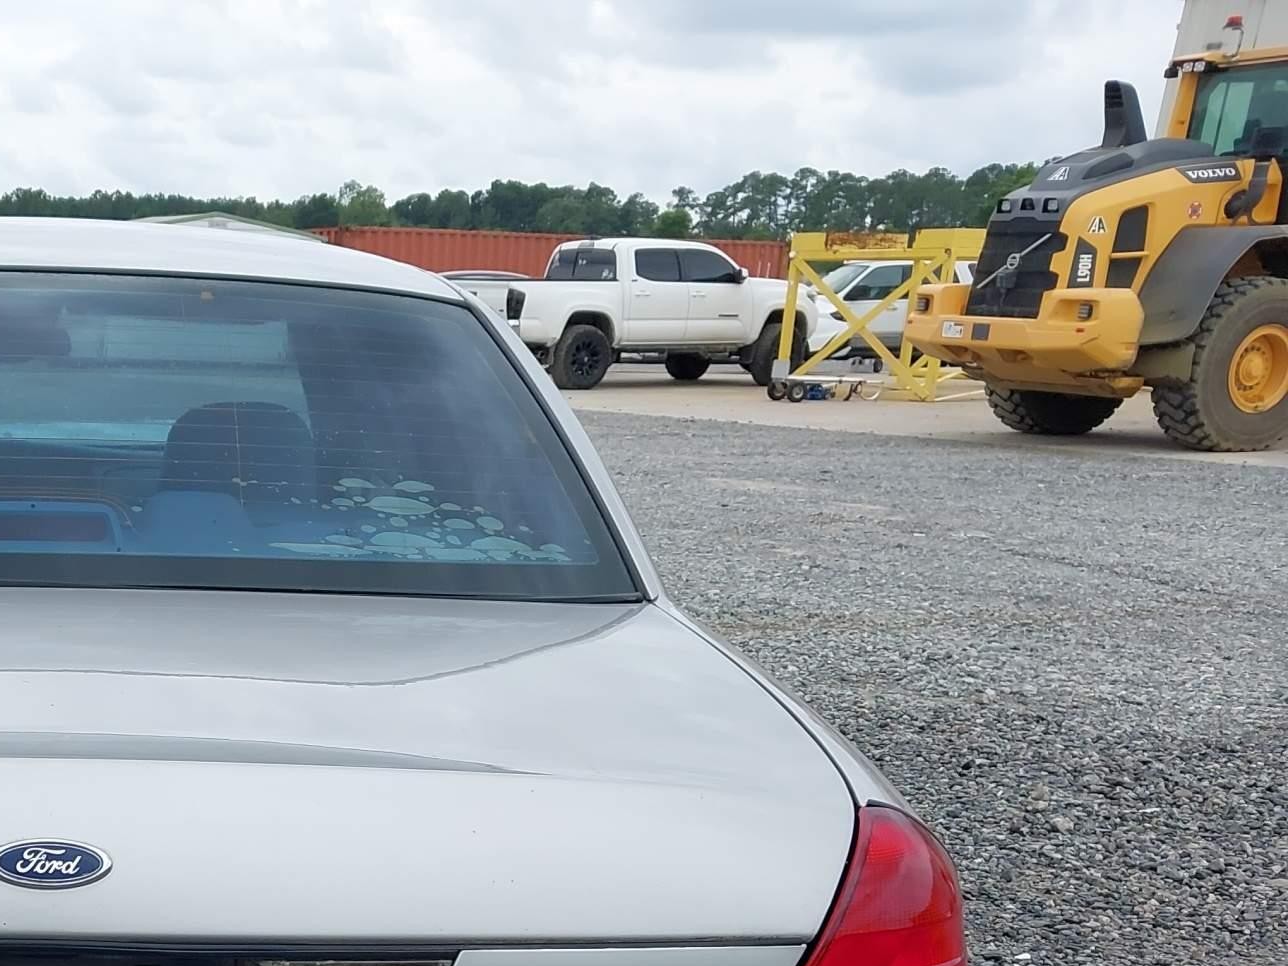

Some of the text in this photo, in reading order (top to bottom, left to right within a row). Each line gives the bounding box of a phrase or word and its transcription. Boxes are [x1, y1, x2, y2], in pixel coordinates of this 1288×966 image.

[1185, 167, 1236, 179] VOLVO
[1076, 253, 1093, 282] L90H
[15, 847, 82, 875] Ford
